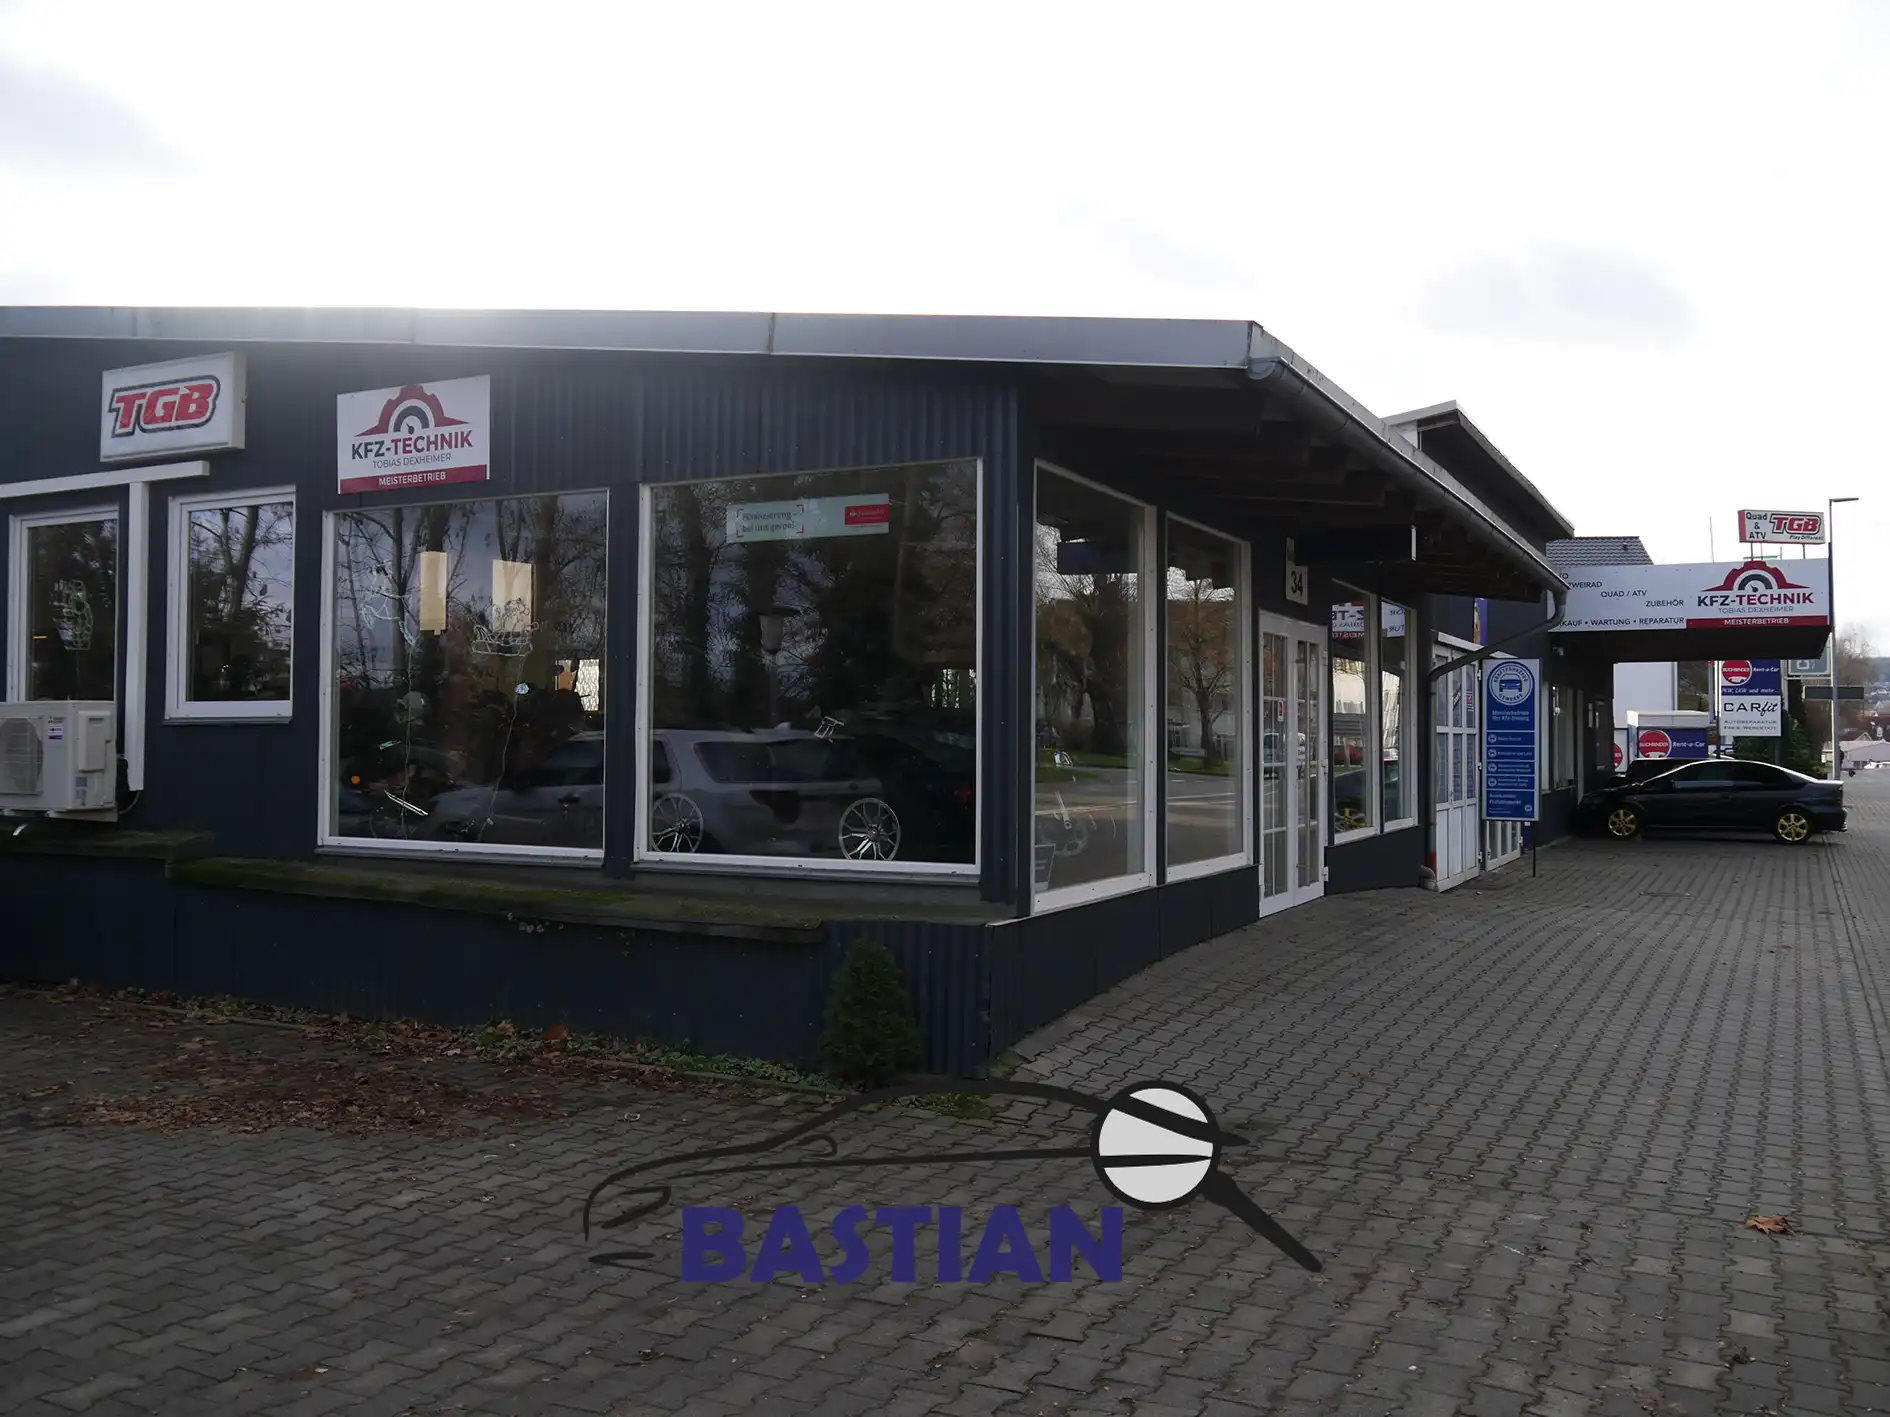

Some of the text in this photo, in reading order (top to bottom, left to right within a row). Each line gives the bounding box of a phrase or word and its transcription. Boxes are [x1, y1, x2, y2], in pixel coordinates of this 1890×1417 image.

[112, 380, 217, 433] TGB
[351, 430, 473, 460] KFZ-TECHNIK
[372, 453, 452, 469] TOBIAS DEXHEIMER
[378, 471, 447, 487] MEISTERBETRIEB
[1745, 512, 1767, 520] Quad
[1754, 522, 1760, 530] &
[1771, 515, 1820, 533] TGB
[1749, 531, 1766, 540] ATV
[1291, 570, 1303, 597] 34
[1600, 590, 1625, 598] QUAD
[1631, 589, 1648, 597] ATV
[1645, 598, 1684, 607] ZUBEHÖR
[1697, 592, 1814, 607] KFZ-TECHNIK
[1718, 605, 1794, 614] TOBIAS DEXHEIMER
[1590, 618, 1631, 626] WARTUNG
[1639, 616, 1685, 625] REPARATUR
[1724, 617, 1789, 626] MEISTERBETRIEB
[1723, 702, 1778, 716] CARfit
[1672, 740, 1706, 748] Rent-a-Car
